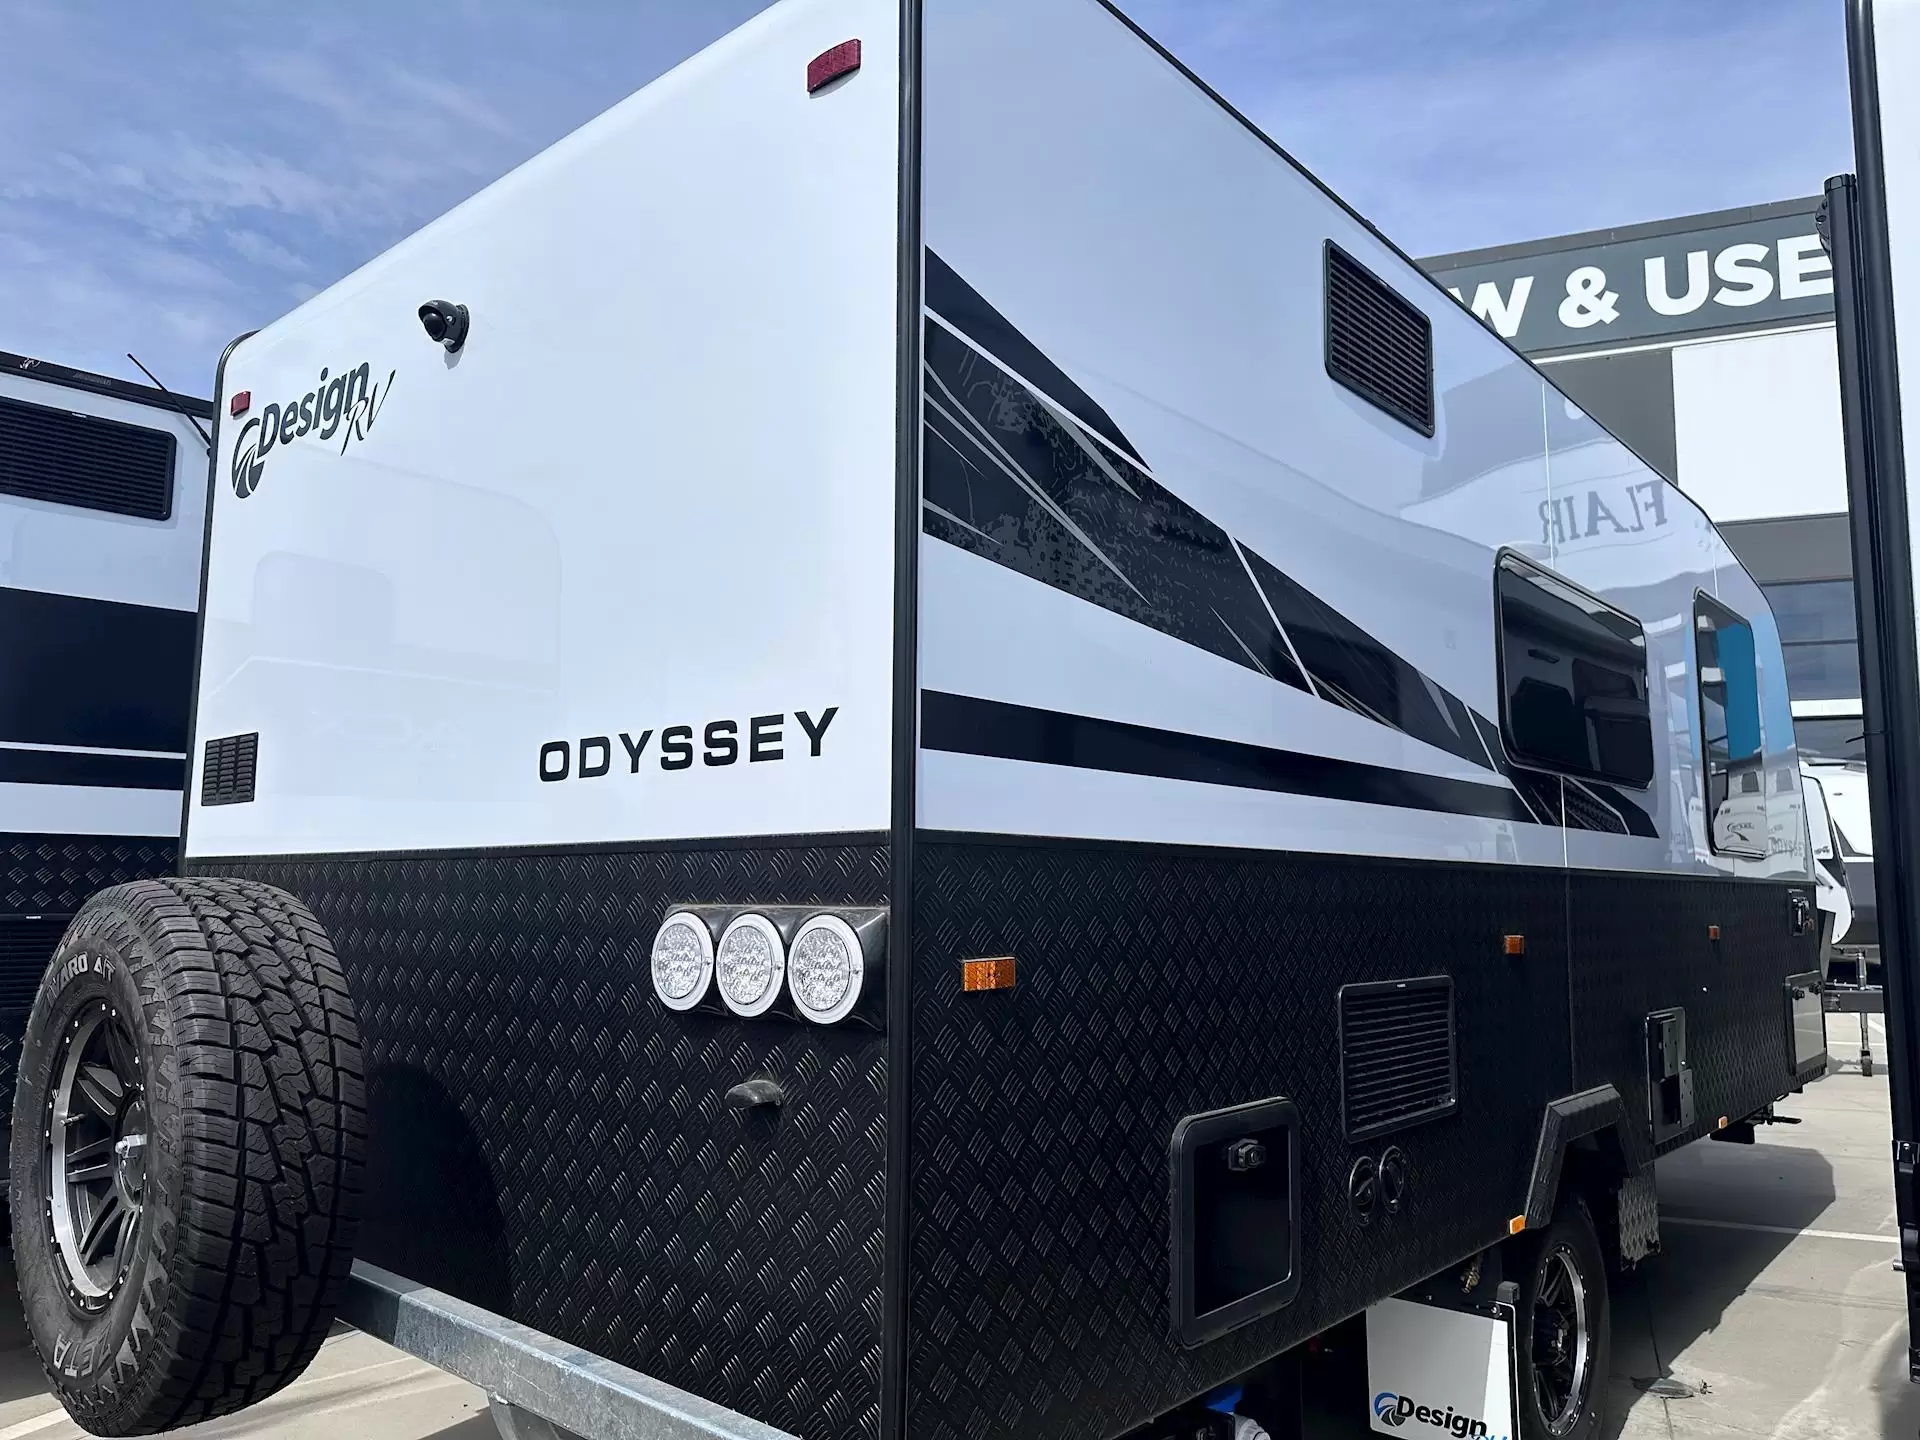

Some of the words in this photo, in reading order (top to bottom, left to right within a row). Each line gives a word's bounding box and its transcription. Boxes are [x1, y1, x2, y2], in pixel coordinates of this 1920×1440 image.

[1558, 266, 1620, 328] &
[256, 362, 370, 459] Design
[341, 369, 396, 456] RV
[539, 707, 839, 782] ODYSSEY
[1396, 1395, 1488, 1439] Design
